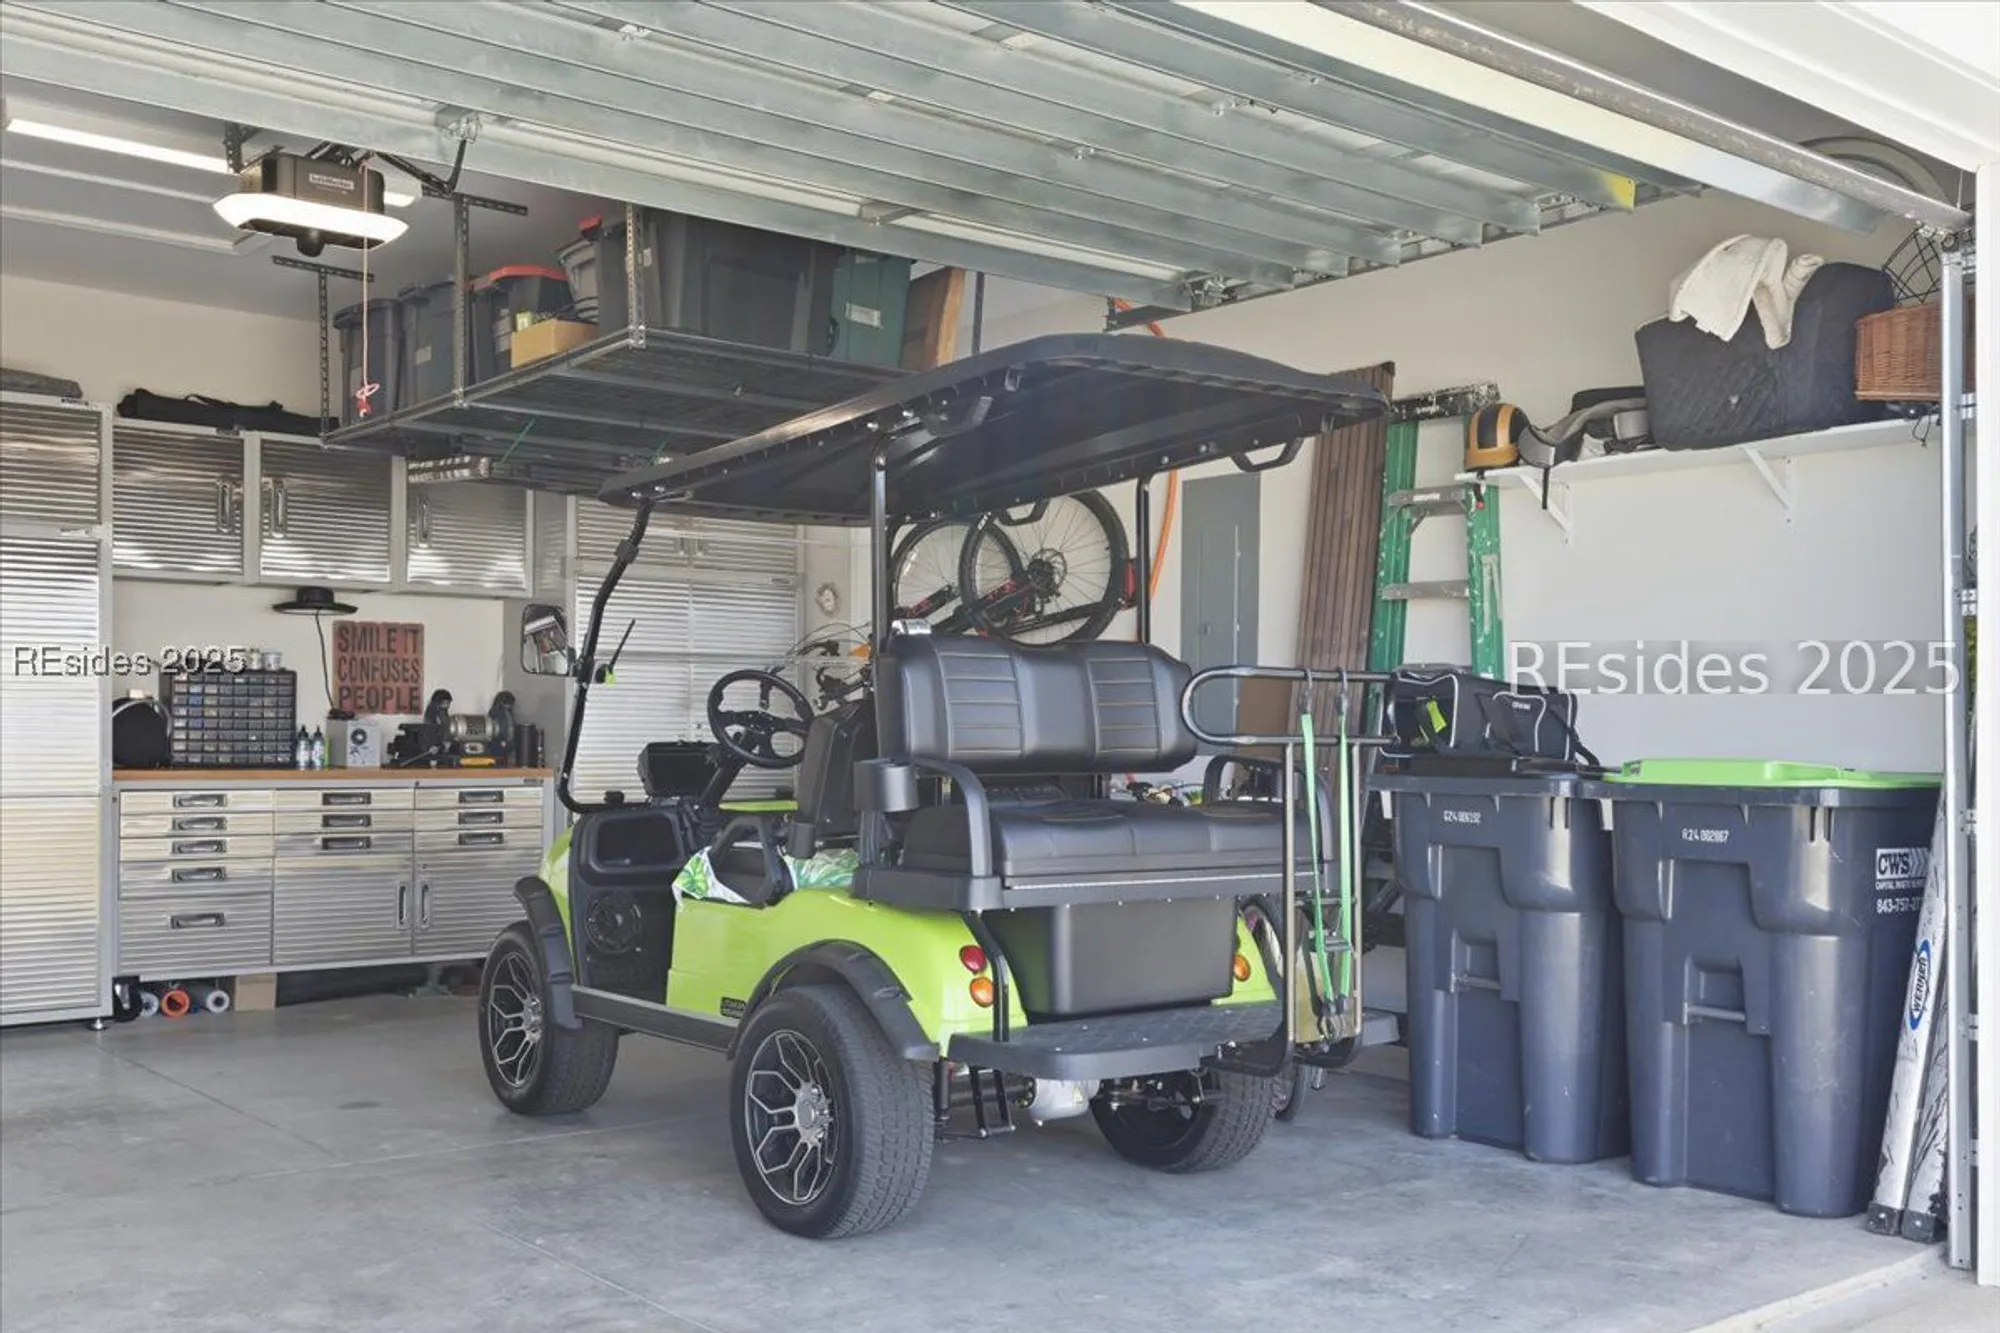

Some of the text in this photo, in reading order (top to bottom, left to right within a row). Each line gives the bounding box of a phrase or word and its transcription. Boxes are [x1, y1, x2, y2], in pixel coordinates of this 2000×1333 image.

[337, 625, 421, 654] SMILE IT
[337, 656, 420, 683] CONFUSES
[338, 685, 420, 711] PEOPLE
[1878, 853, 1909, 875] CWS
[1913, 956, 1927, 1012] WERNER
